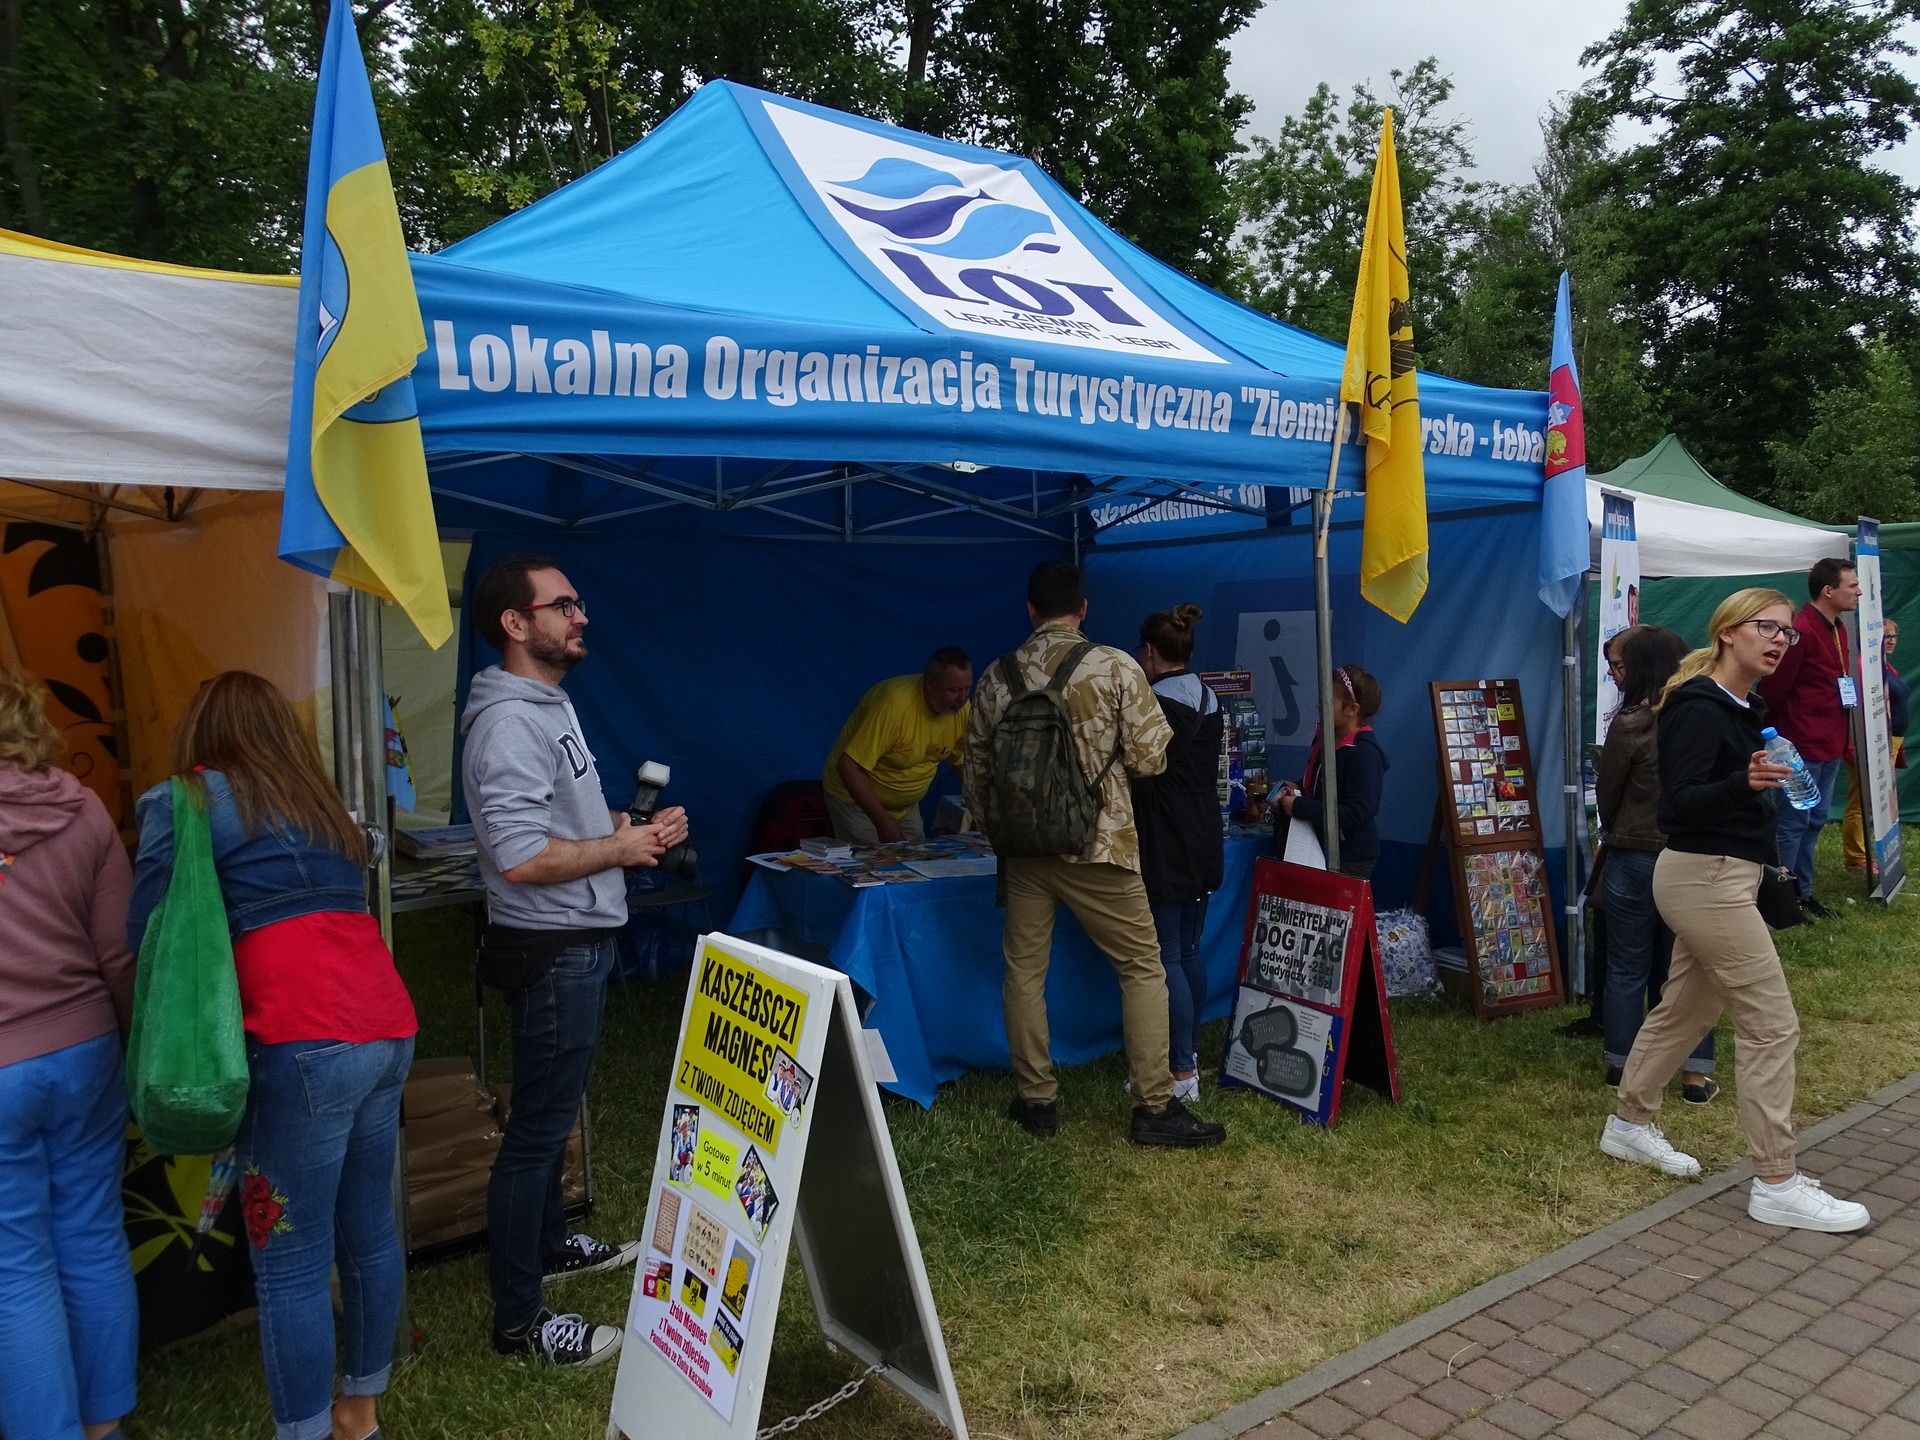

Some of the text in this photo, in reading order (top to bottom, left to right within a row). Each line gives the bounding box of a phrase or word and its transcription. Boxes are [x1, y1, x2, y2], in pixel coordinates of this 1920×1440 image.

[880, 247, 1145, 328] LOT
[1003, 310, 1100, 332] ZIEMIA
[433, 319, 688, 399] Lokalna
[702, 335, 1001, 413] Organizacja
[1009, 357, 1231, 433] Turystyczna
[1255, 922, 1343, 963] DOG TAG
[699, 957, 801, 1045] KASZËBSCZI
[703, 1011, 774, 1085] MAGNES
[681, 1059, 776, 1145] Z TWOIM ZDJĘCIEM
[702, 1138, 731, 1165] Gotowe
[703, 1159, 711, 1175] 5
[711, 1164, 732, 1190] minut
[682, 1312, 708, 1346] Magnes
